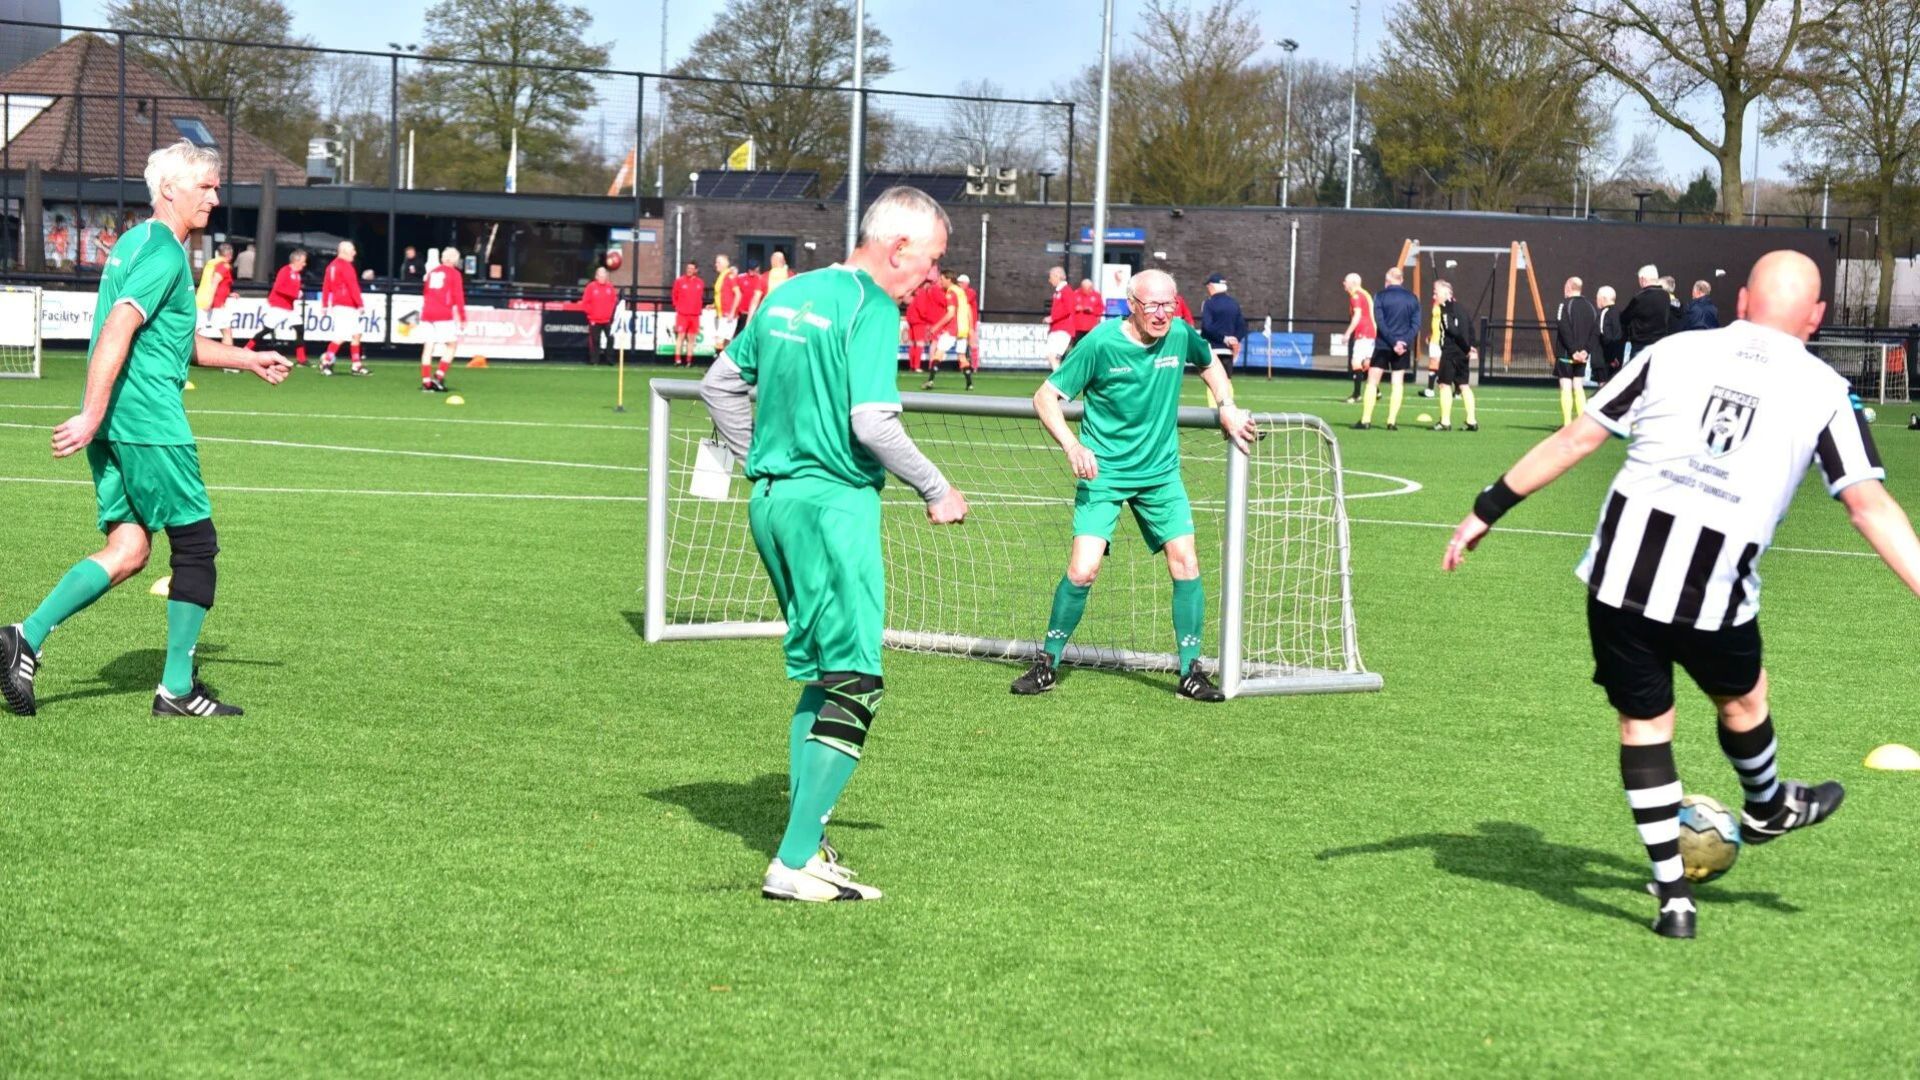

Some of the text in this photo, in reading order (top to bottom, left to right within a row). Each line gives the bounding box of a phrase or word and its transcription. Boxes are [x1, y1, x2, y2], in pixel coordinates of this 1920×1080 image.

[42, 309, 93, 323] Facility Tr
[231, 306, 266, 330] ank
